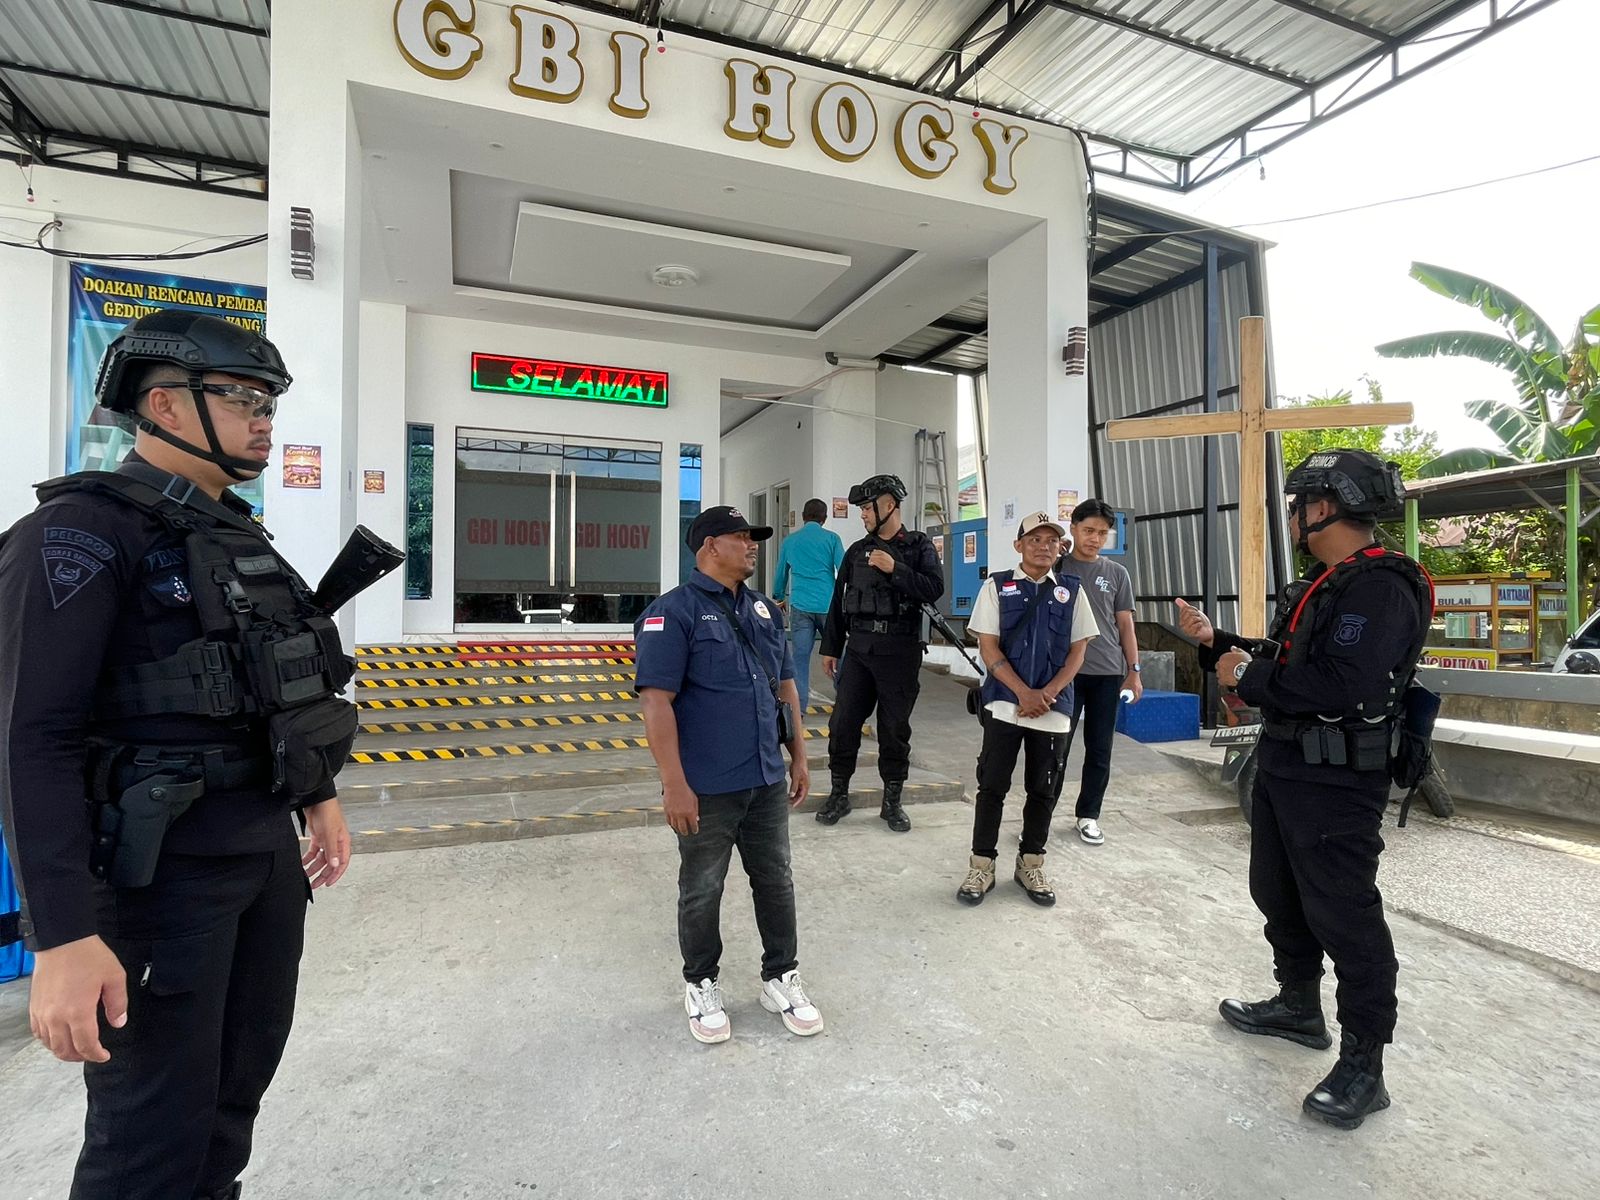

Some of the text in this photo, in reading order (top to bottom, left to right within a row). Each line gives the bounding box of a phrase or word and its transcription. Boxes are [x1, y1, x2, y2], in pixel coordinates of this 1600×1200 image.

[393, 0, 1029, 195] GBI HOGY
[83, 277, 143, 298] DOAKAN
[147, 286, 214, 306] RENCANA
[103, 301, 162, 319] GEDUN
[507, 361, 664, 401] SELAMAT
[467, 518, 551, 546] GBI HOGY
[575, 522, 651, 549] GBI HOGY
[1497, 588, 1530, 601] MARTABAK
